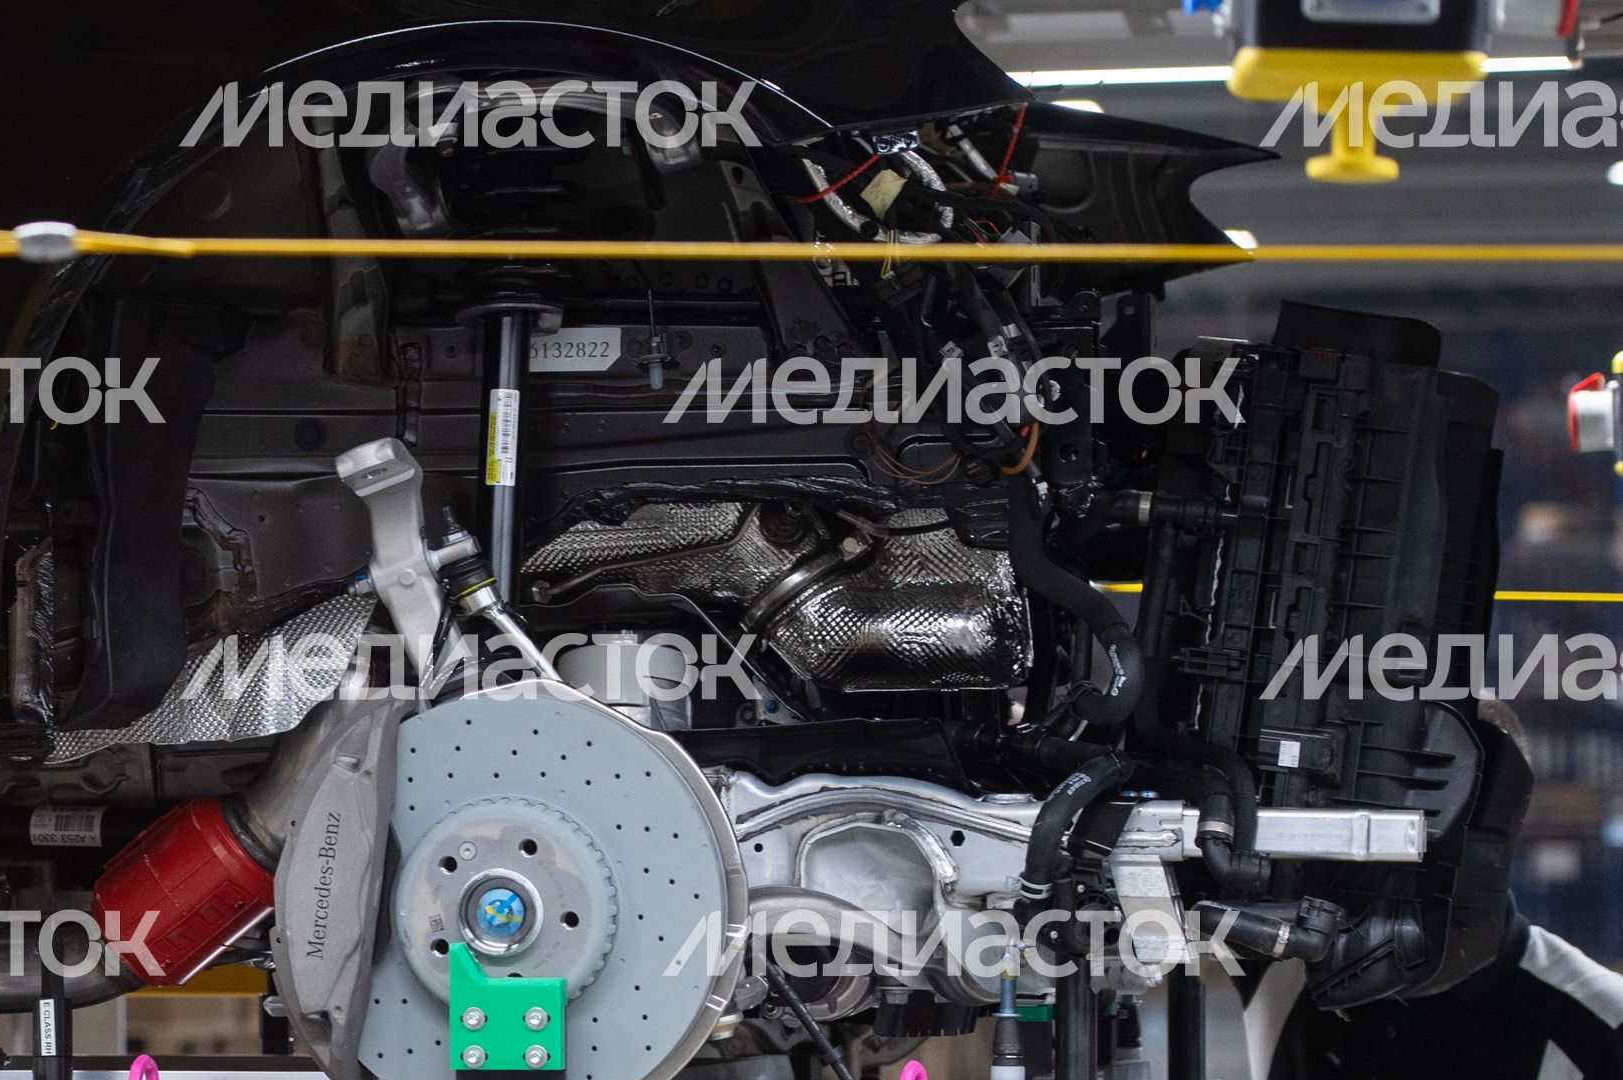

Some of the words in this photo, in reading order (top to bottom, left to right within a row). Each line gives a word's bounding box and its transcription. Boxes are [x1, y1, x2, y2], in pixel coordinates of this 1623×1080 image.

[307, 812, 342, 961] Mercedes-Benz
[43, 1009, 52, 1040] CLASS
[44, 1041, 53, 1054] RH
